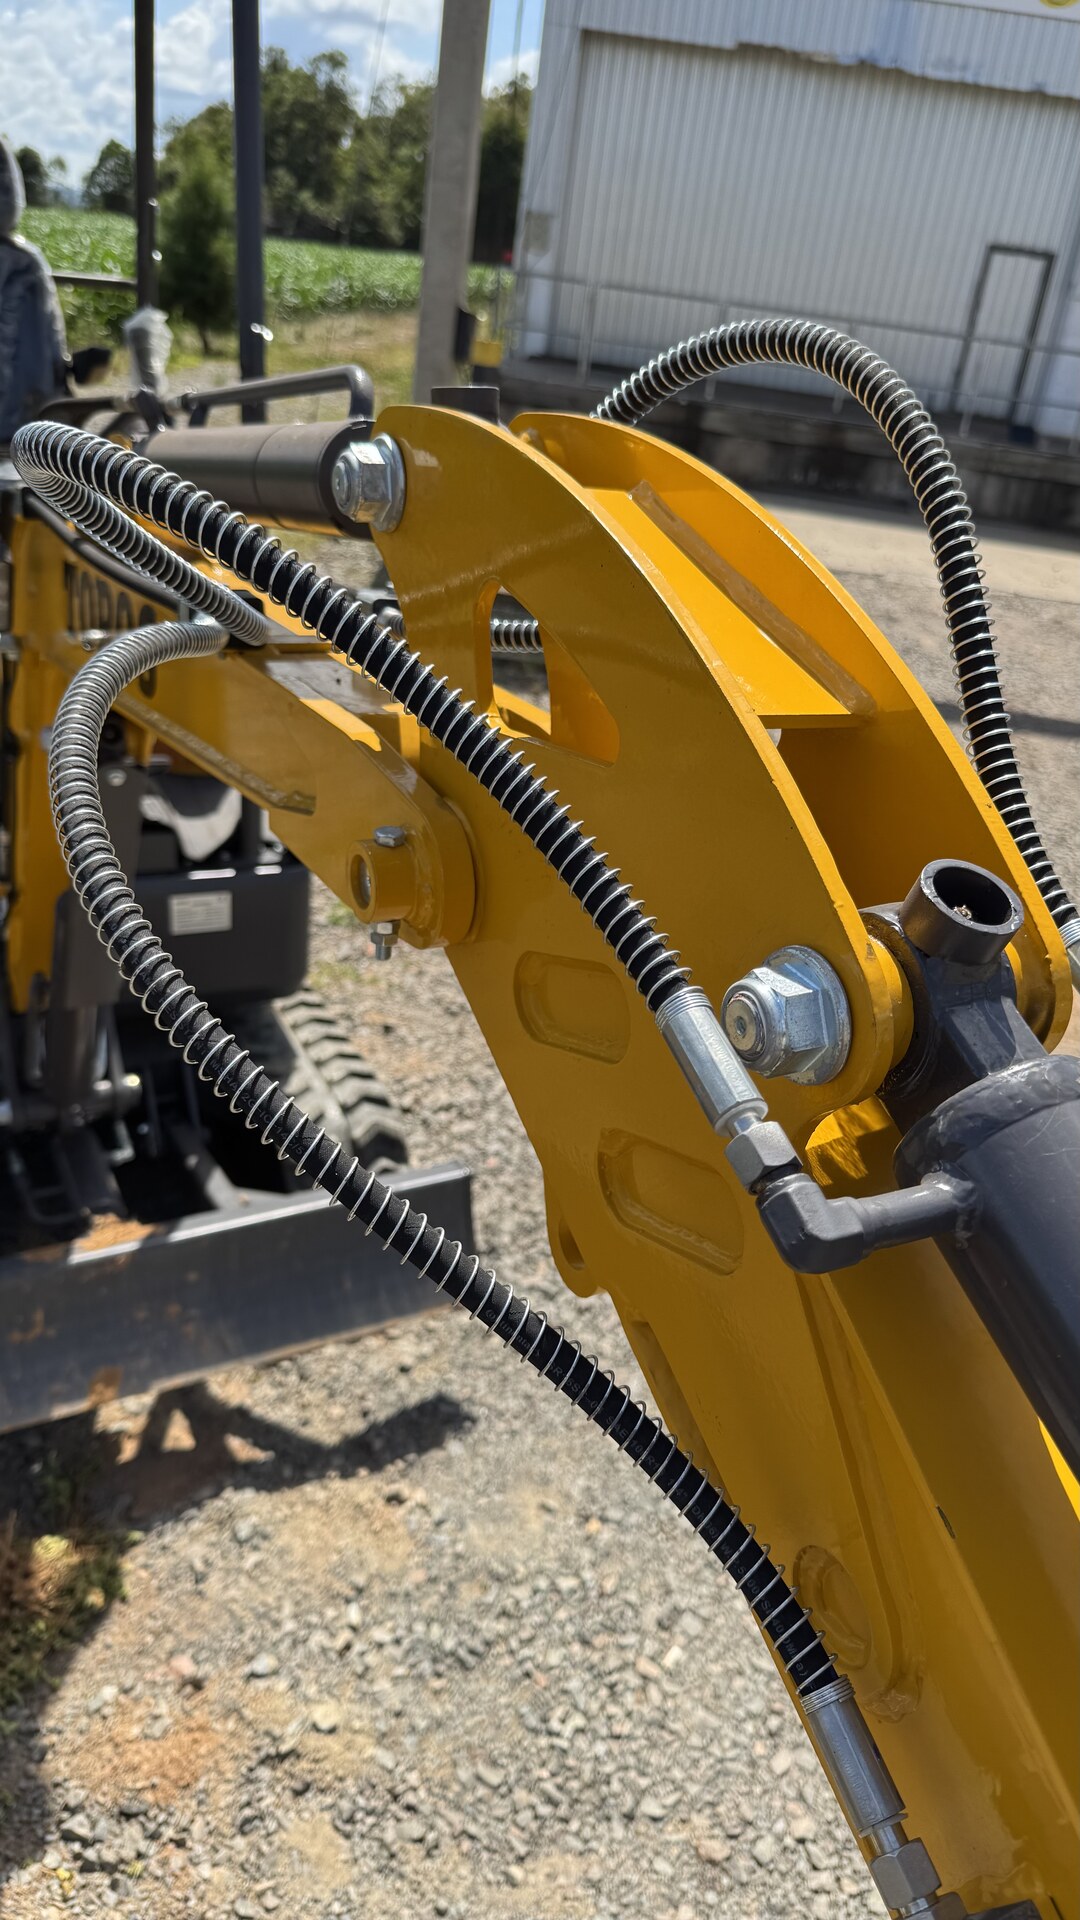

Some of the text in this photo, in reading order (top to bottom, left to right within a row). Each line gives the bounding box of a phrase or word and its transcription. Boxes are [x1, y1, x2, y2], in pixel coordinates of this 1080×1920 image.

[128, 957, 161, 996] FAME
[157, 995, 209, 1056] RESSTANT
[604, 1413, 630, 1439] SAE
[628, 1437, 666, 1477] 10R1
